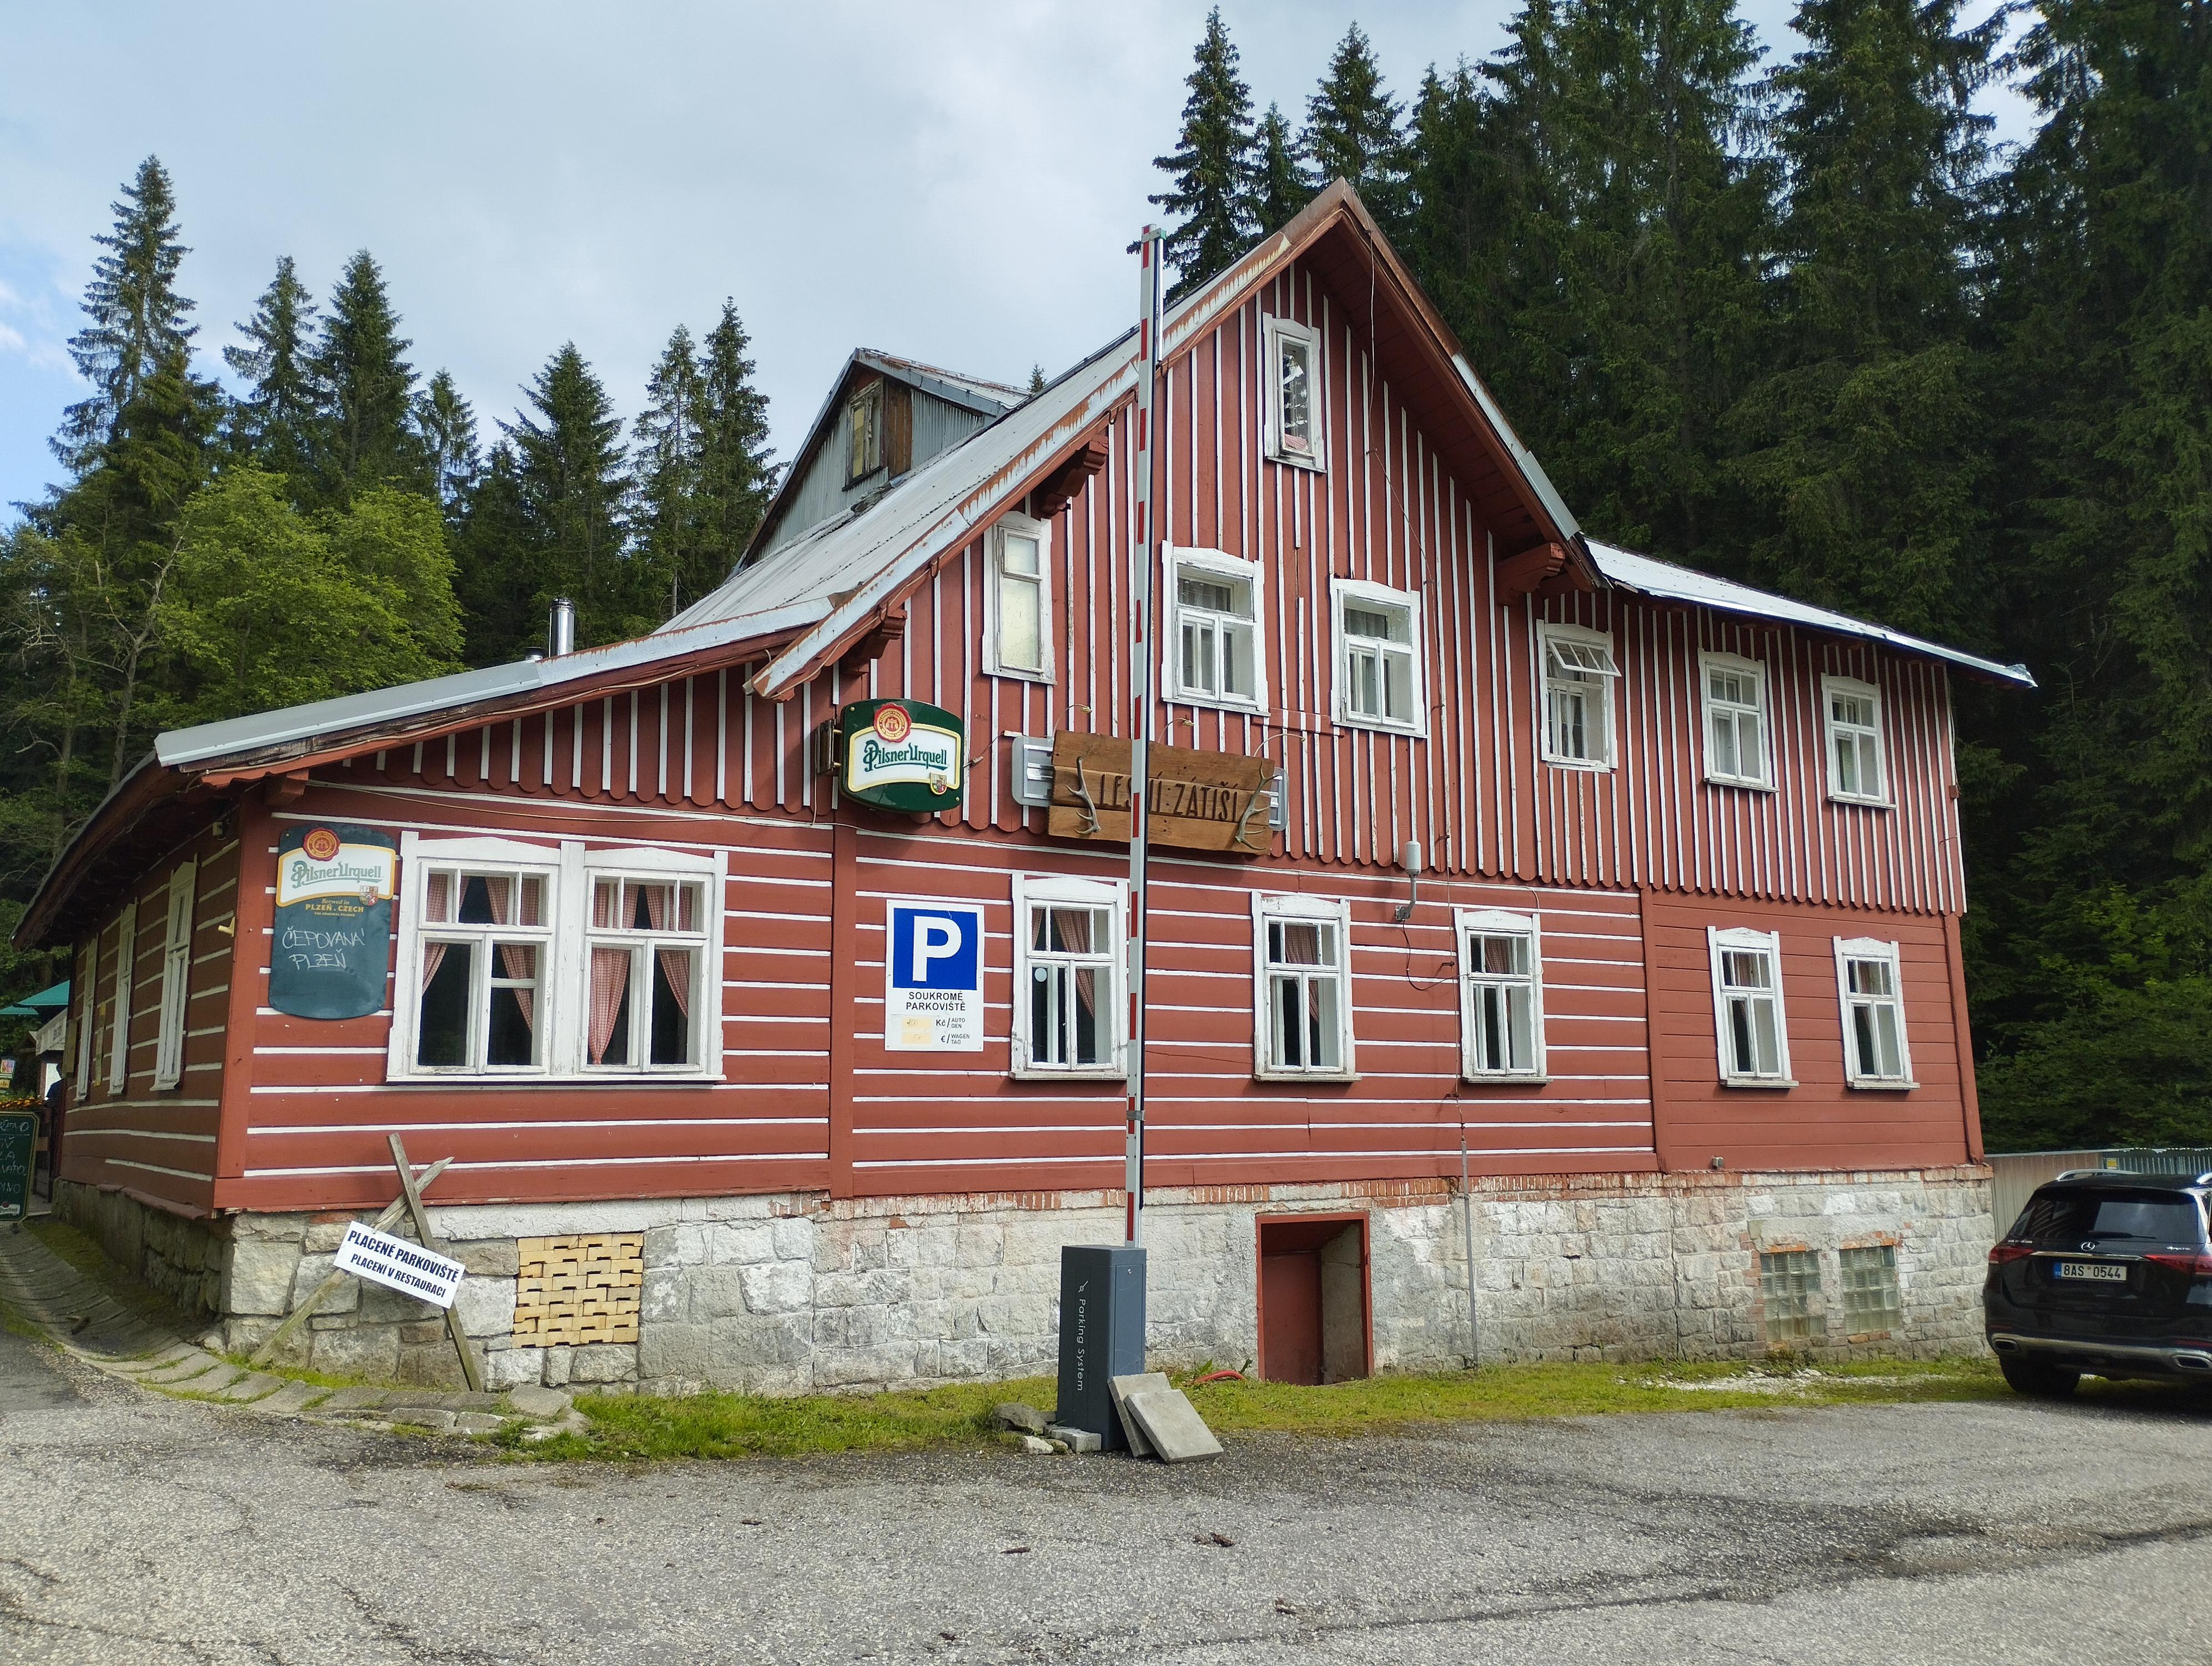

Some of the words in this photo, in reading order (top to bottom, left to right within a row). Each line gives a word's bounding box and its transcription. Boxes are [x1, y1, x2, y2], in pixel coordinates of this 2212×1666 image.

[863, 740, 909, 772] Pilsner
[908, 742, 947, 769] Urquell
[1173, 776, 1238, 822] ZÁTIŠÍ
[291, 861, 339, 889] Pilsner
[338, 861, 382, 883] Urquell
[289, 949, 347, 970] PLZEŇ
[912, 915, 962, 982] P
[906, 1001, 966, 1011] PARKOVIŠTĚ
[908, 991, 963, 1001] SOUKROMÉ
[348, 1230, 396, 1257] PLACENÉ
[395, 1248, 460, 1283] PARKOVIŠTĚ
[350, 1253, 389, 1274] PLACENÍ
[388, 1267, 395, 1277] V
[2064, 1265, 2084, 1277] 8AS
[2093, 1267, 2121, 1278] 0544
[1077, 1299, 1086, 1344] Parking
[1076, 1348, 1085, 1391] System
